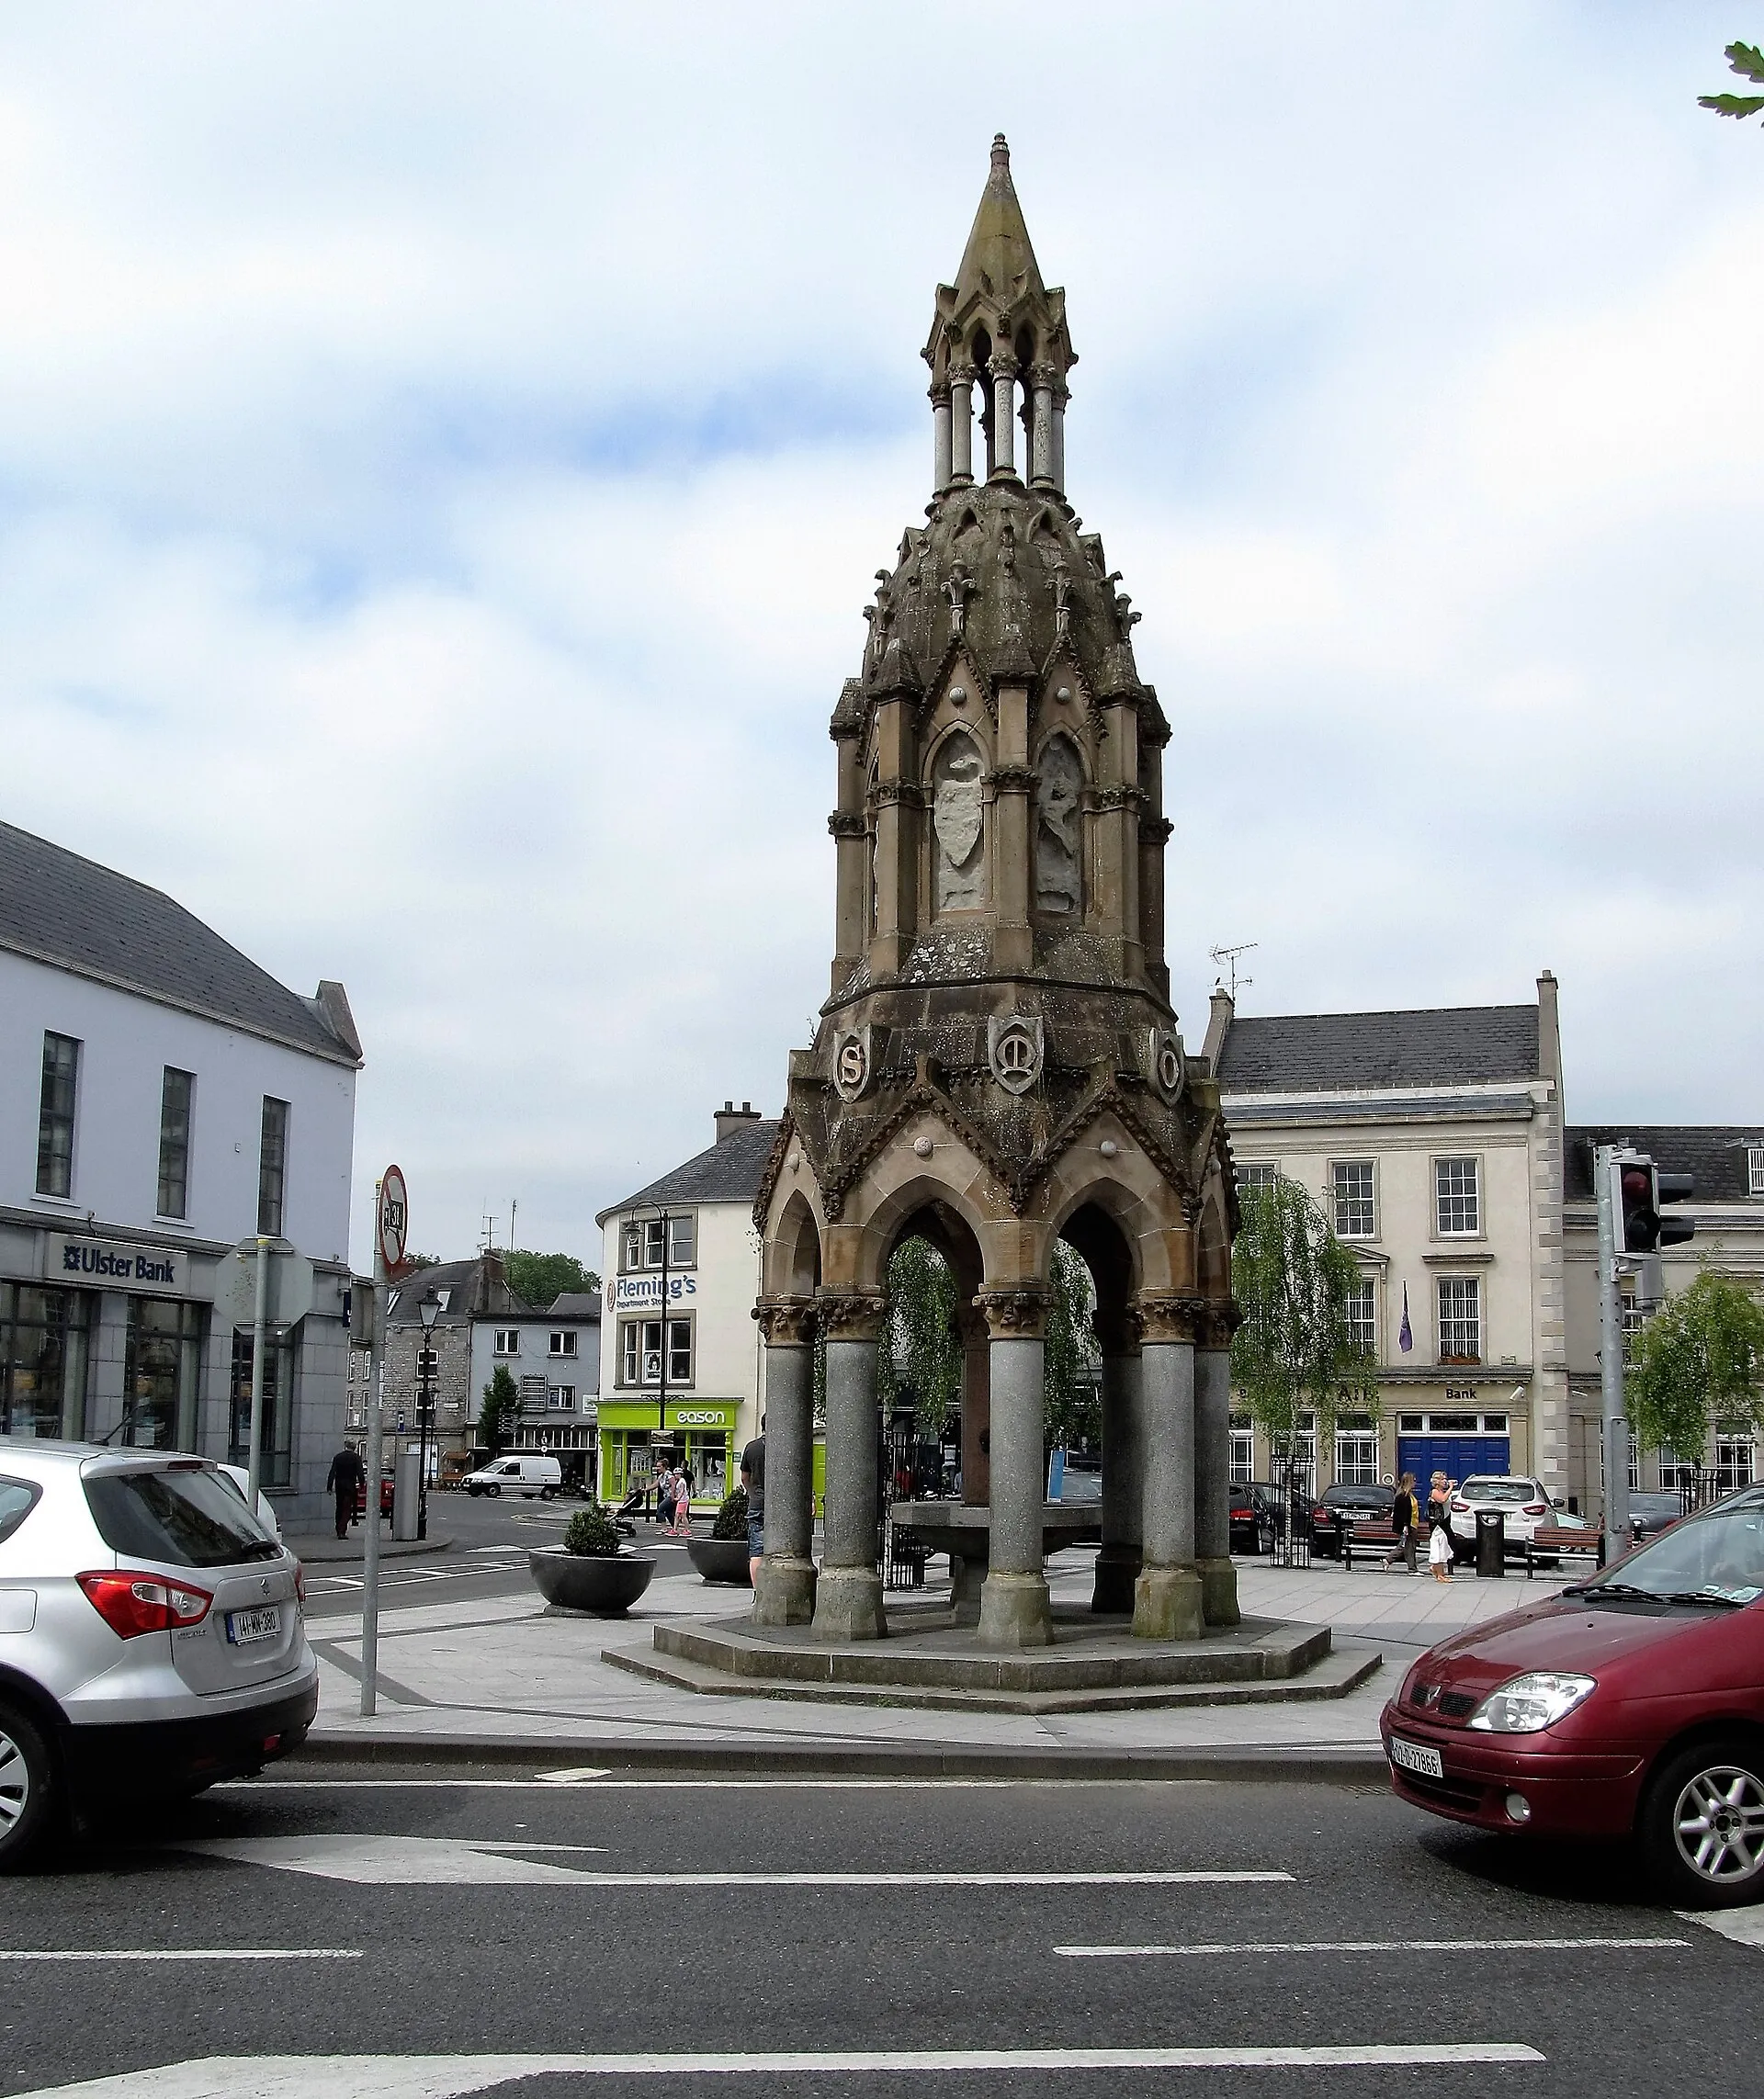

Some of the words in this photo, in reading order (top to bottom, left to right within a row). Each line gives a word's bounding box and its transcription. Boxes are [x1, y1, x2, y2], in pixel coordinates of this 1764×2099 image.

[841, 1044, 863, 1084] S
[82, 1247, 133, 1277] Ulster
[135, 1255, 175, 1282] Bank
[616, 1274, 696, 1299] Fleming's
[650, 1297, 672, 1305] Stoe
[1445, 1387, 1477, 1399] Bank
[677, 1411, 725, 1424] eason
